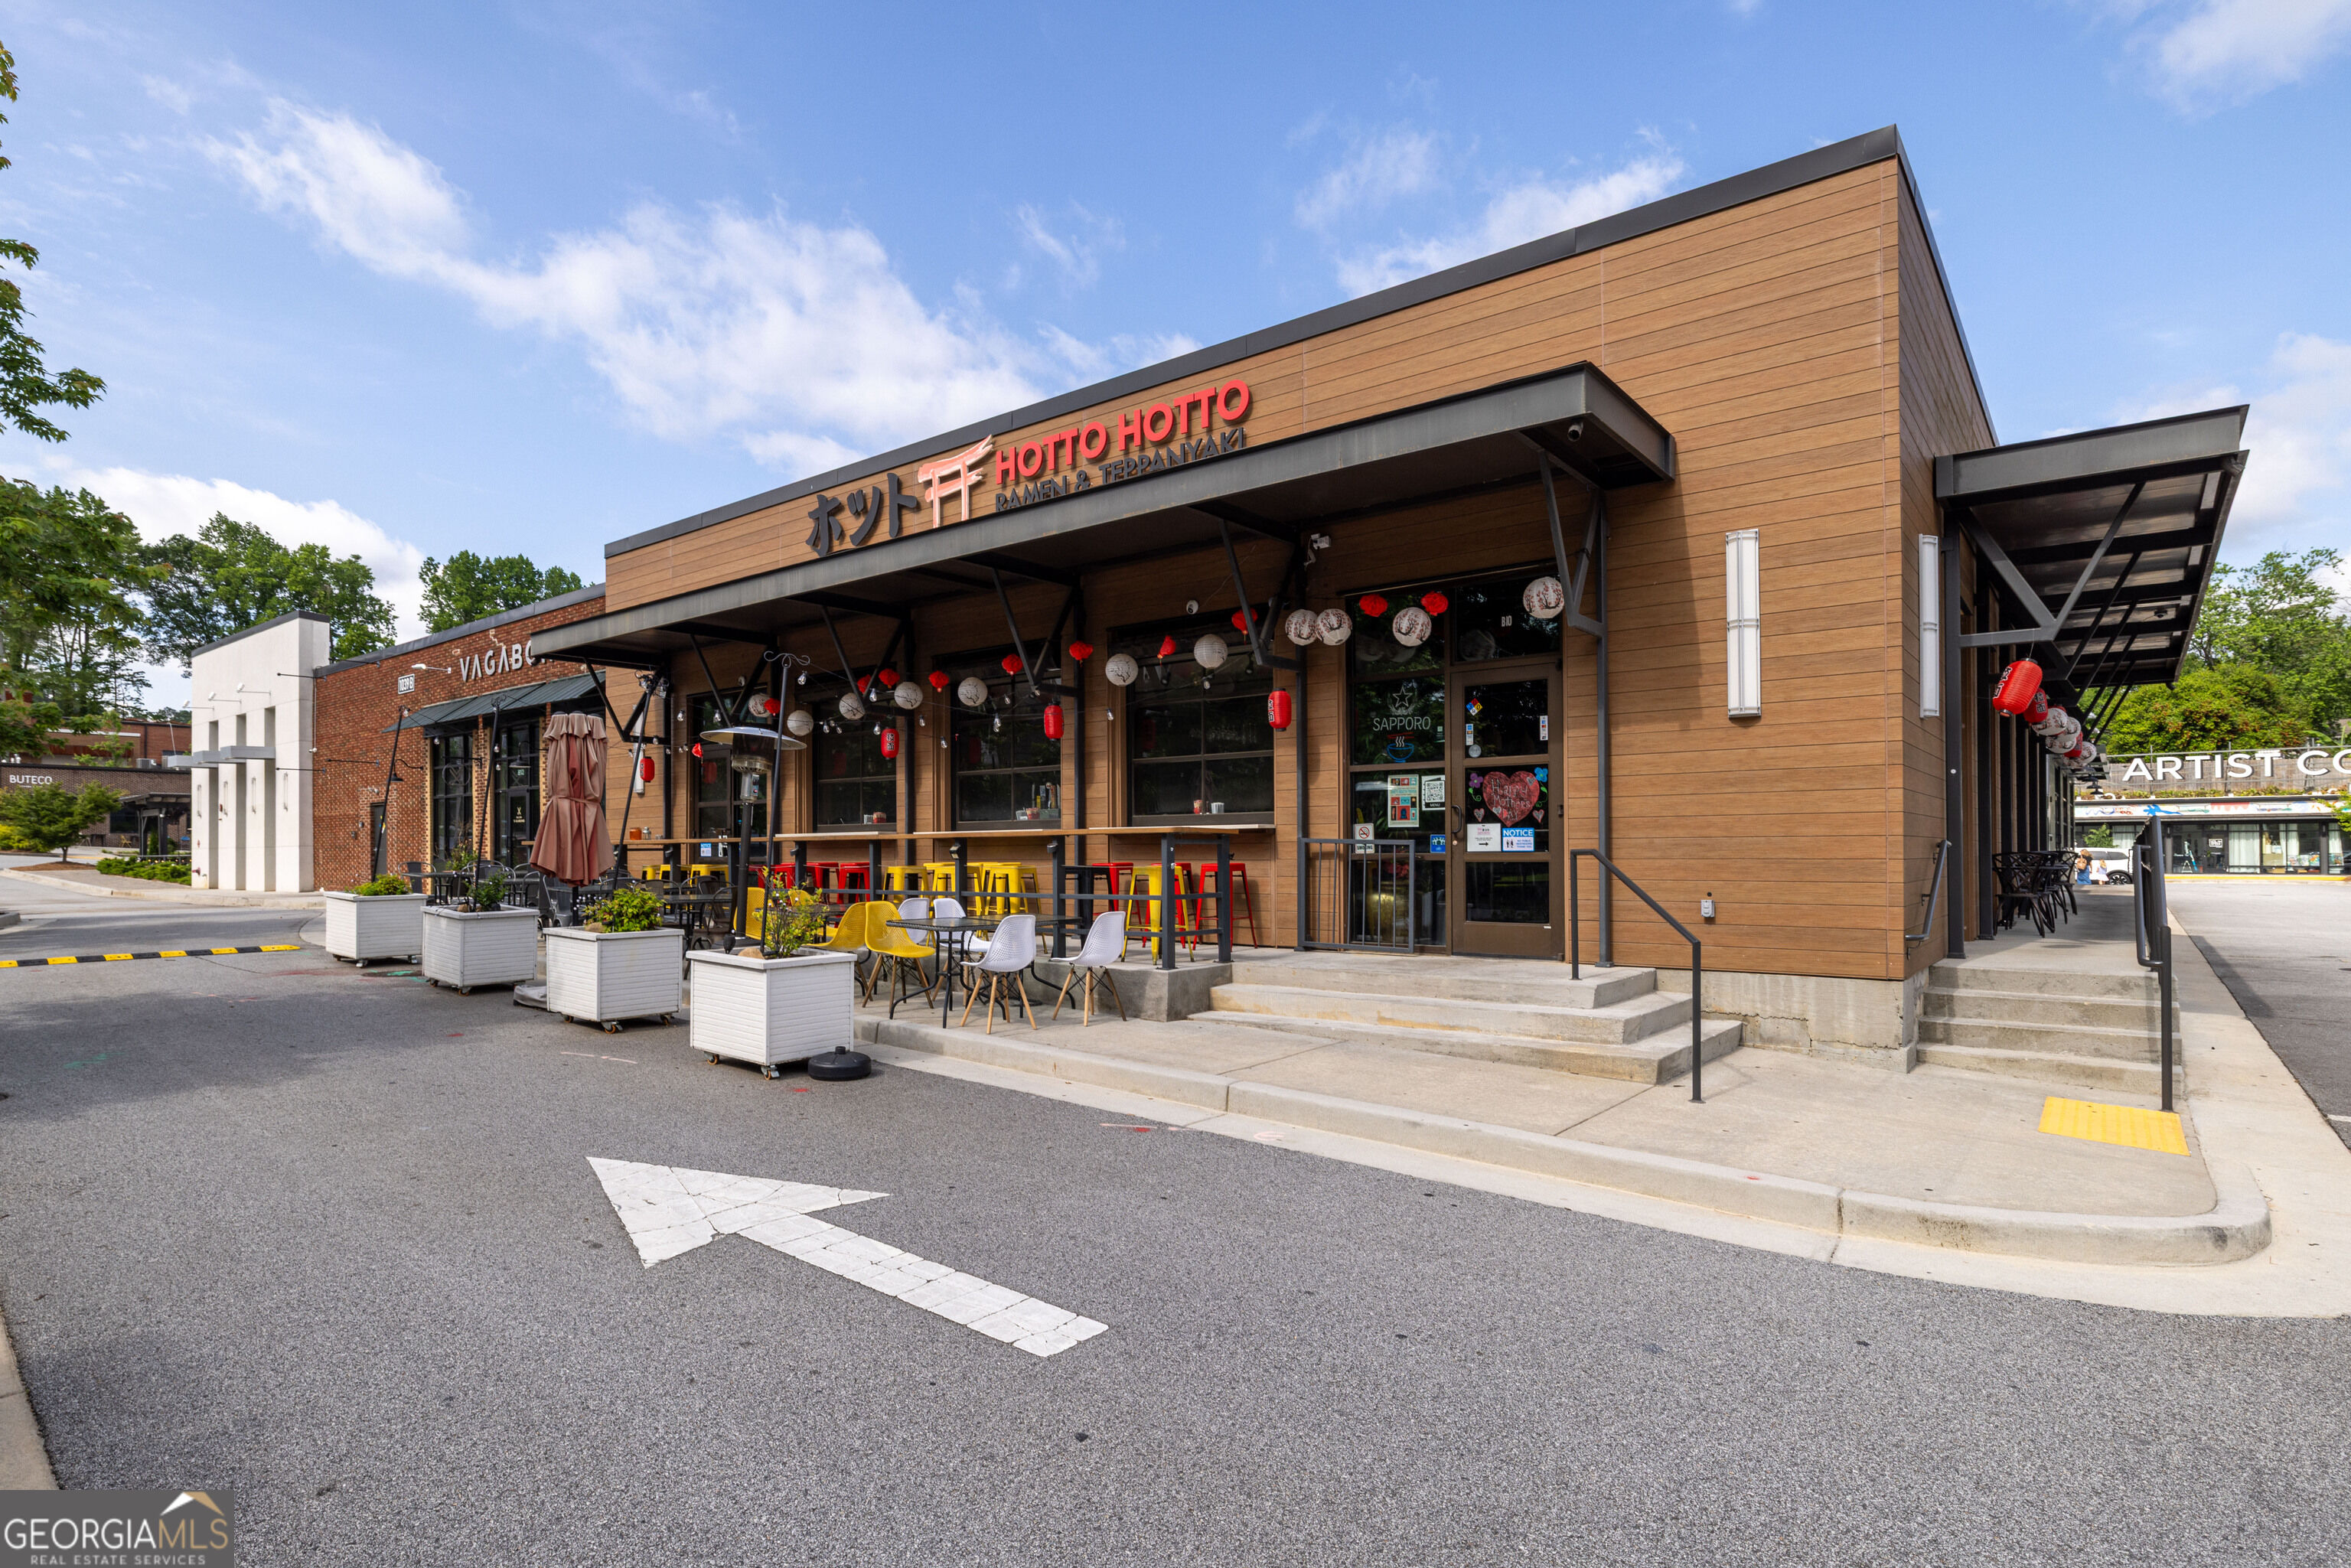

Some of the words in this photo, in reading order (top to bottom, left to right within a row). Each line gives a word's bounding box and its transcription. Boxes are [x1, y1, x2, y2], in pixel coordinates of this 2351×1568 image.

[996, 421, 1108, 485] HOTTO
[1117, 380, 1250, 451] HOTTO
[995, 474, 1068, 512] RAMEN
[1074, 469, 1092, 492] &
[1098, 426, 1244, 485] TEPPANYAKI
[805, 472, 918, 558] ホット
[1372, 716, 1431, 731] SAPPORO
[9, 774, 53, 784] BUTECO
[2121, 749, 2281, 781] ARTIST
